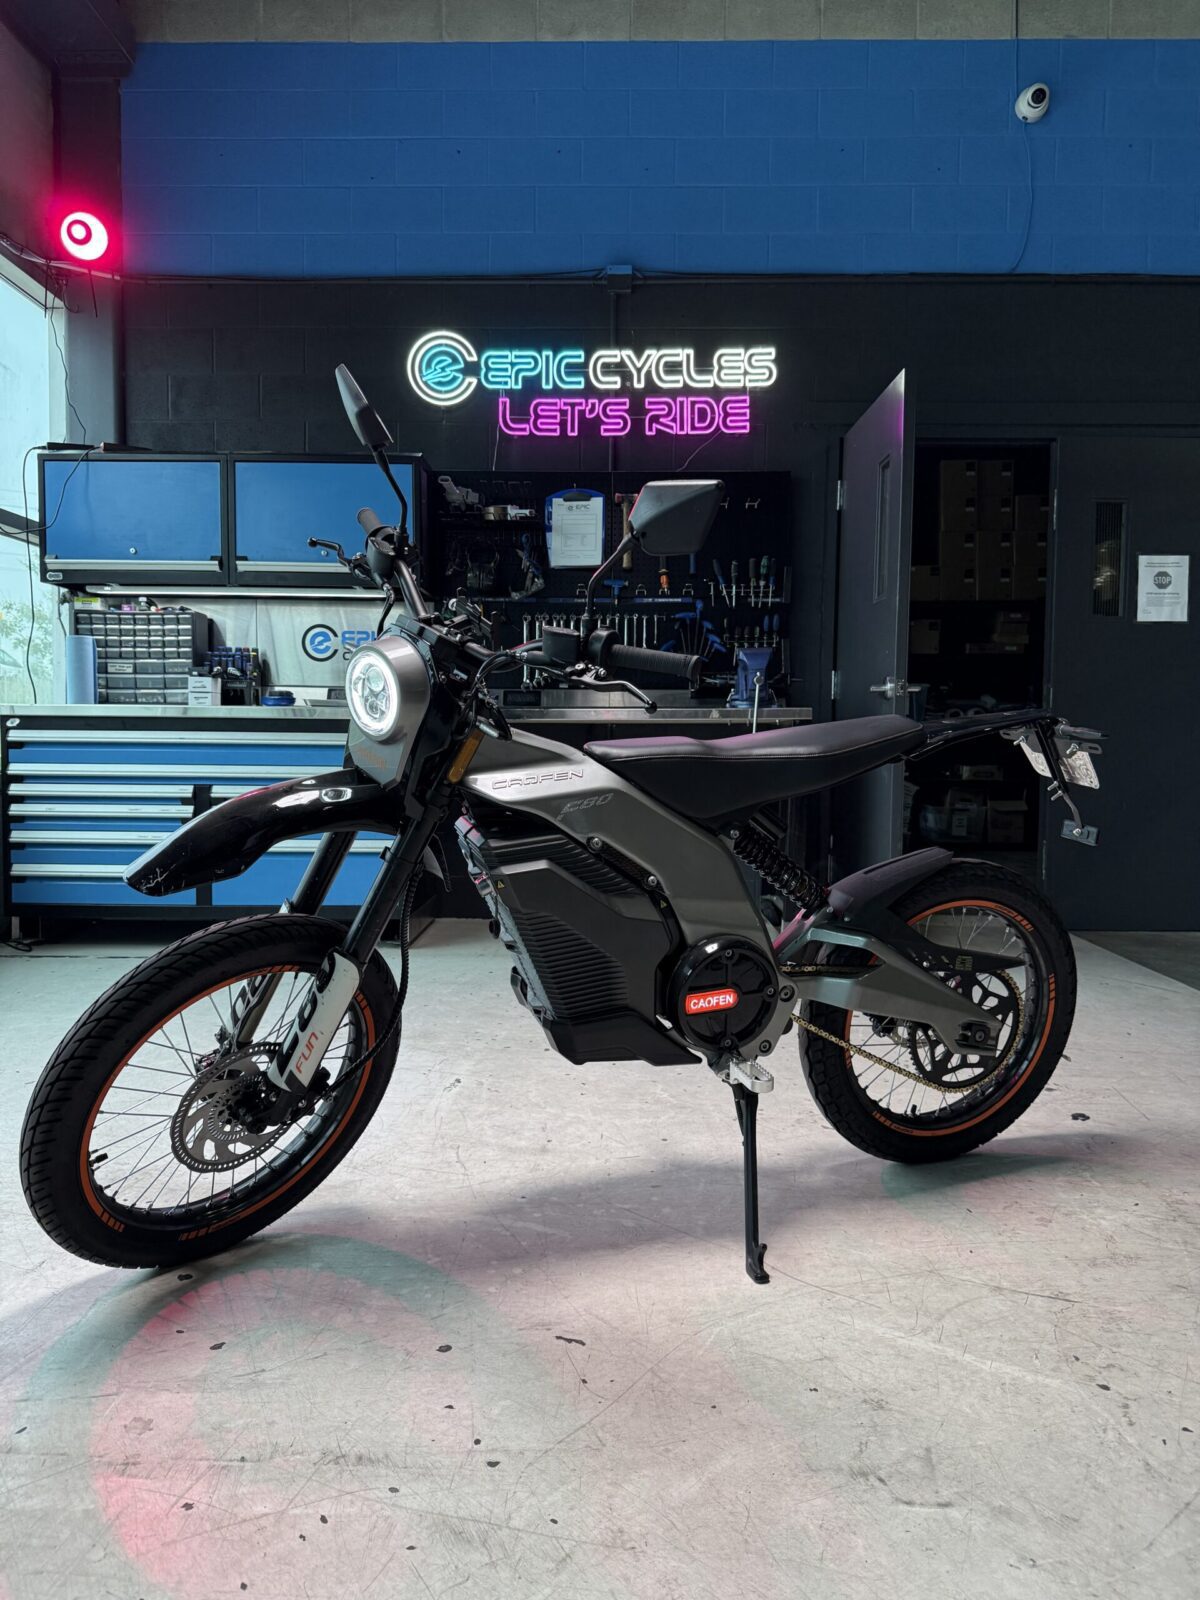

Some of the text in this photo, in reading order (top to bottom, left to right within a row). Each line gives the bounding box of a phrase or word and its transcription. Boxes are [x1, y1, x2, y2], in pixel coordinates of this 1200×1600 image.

[480, 348, 586, 391] EPIC
[588, 346, 779, 390] CYCLES
[498, 395, 751, 437] LET'S RIDE
[1153, 576, 1172, 585] STOP
[341, 630, 377, 647] EPI
[690, 992, 734, 1010] CAOFEN
